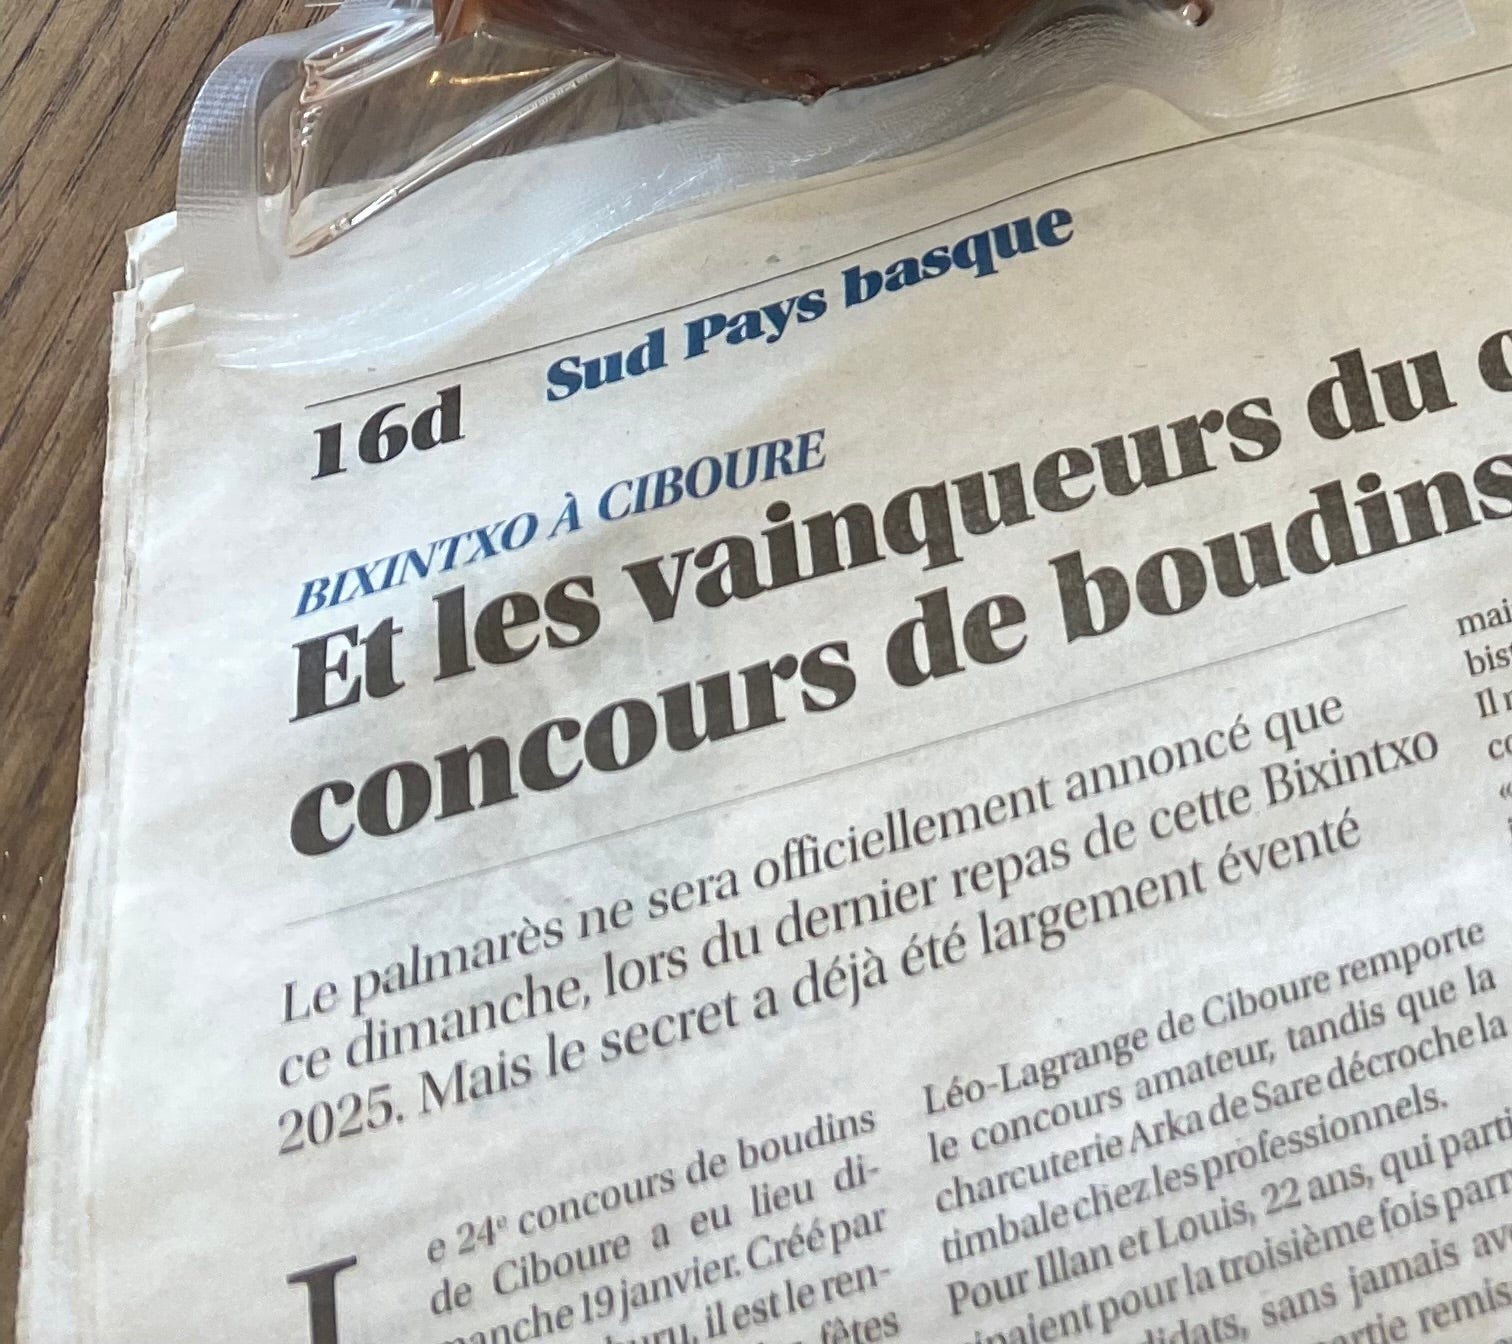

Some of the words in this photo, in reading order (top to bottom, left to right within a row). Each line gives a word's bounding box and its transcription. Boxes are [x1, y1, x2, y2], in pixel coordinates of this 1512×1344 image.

[545, 334, 667, 403] Sud
[683, 285, 829, 365] Pays
[843, 205, 1075, 310] basque
[288, 617, 405, 724] Et
[430, 567, 602, 684] les
[622, 390, 1284, 624] vainqueurs
[1305, 348, 1459, 444] du
[292, 511, 539, 620] BIXINTXO
[548, 491, 583, 540] À
[599, 428, 828, 524] CIBOURE
[309, 385, 466, 482] 16d
[289, 637, 859, 858] concours
[886, 582, 1028, 692] de
[279, 1045, 332, 1088] ce
[346, 973, 593, 1070] dimanche,
[602, 939, 689, 1000] lors
[701, 920, 762, 970] du
[774, 865, 939, 948] dernier
[951, 833, 1073, 905] repas
[1084, 807, 1138, 862] de
[1149, 776, 1253, 841] cette
[1263, 726, 1440, 808] Bixintxo
[282, 980, 338, 1025] Le
[351, 914, 564, 1016] palmarès
[578, 895, 633, 939] ne
[648, 868, 739, 921] sera
[753, 778, 1055, 891] officiellement
[1065, 713, 1253, 803] annoncé
[1263, 690, 1346, 751] que
[278, 1082, 406, 1156] 2025.
[419, 1050, 534, 1120] Mais
[548, 1030, 586, 1078] le
[601, 990, 740, 1064] secret
[753, 982, 779, 1018] a
[791, 948, 891, 1010] déjà
[901, 921, 967, 980] été
[978, 860, 1207, 956] largement
[1215, 805, 1364, 887] éventé
[922, 1026, 1149, 1115] Léo-Lagrange
[1156, 1009, 1195, 1042] de
[1203, 968, 1331, 1028] Ciboure
[1337, 921, 1486, 987] remporte
[430, 1278, 473, 1316] de
[492, 1232, 632, 1297] Ciboure
[651, 1223, 671, 1251] a
[690, 1202, 733, 1238] eu
[751, 1178, 816, 1218] lieu
[833, 1154, 882, 1194] di-
